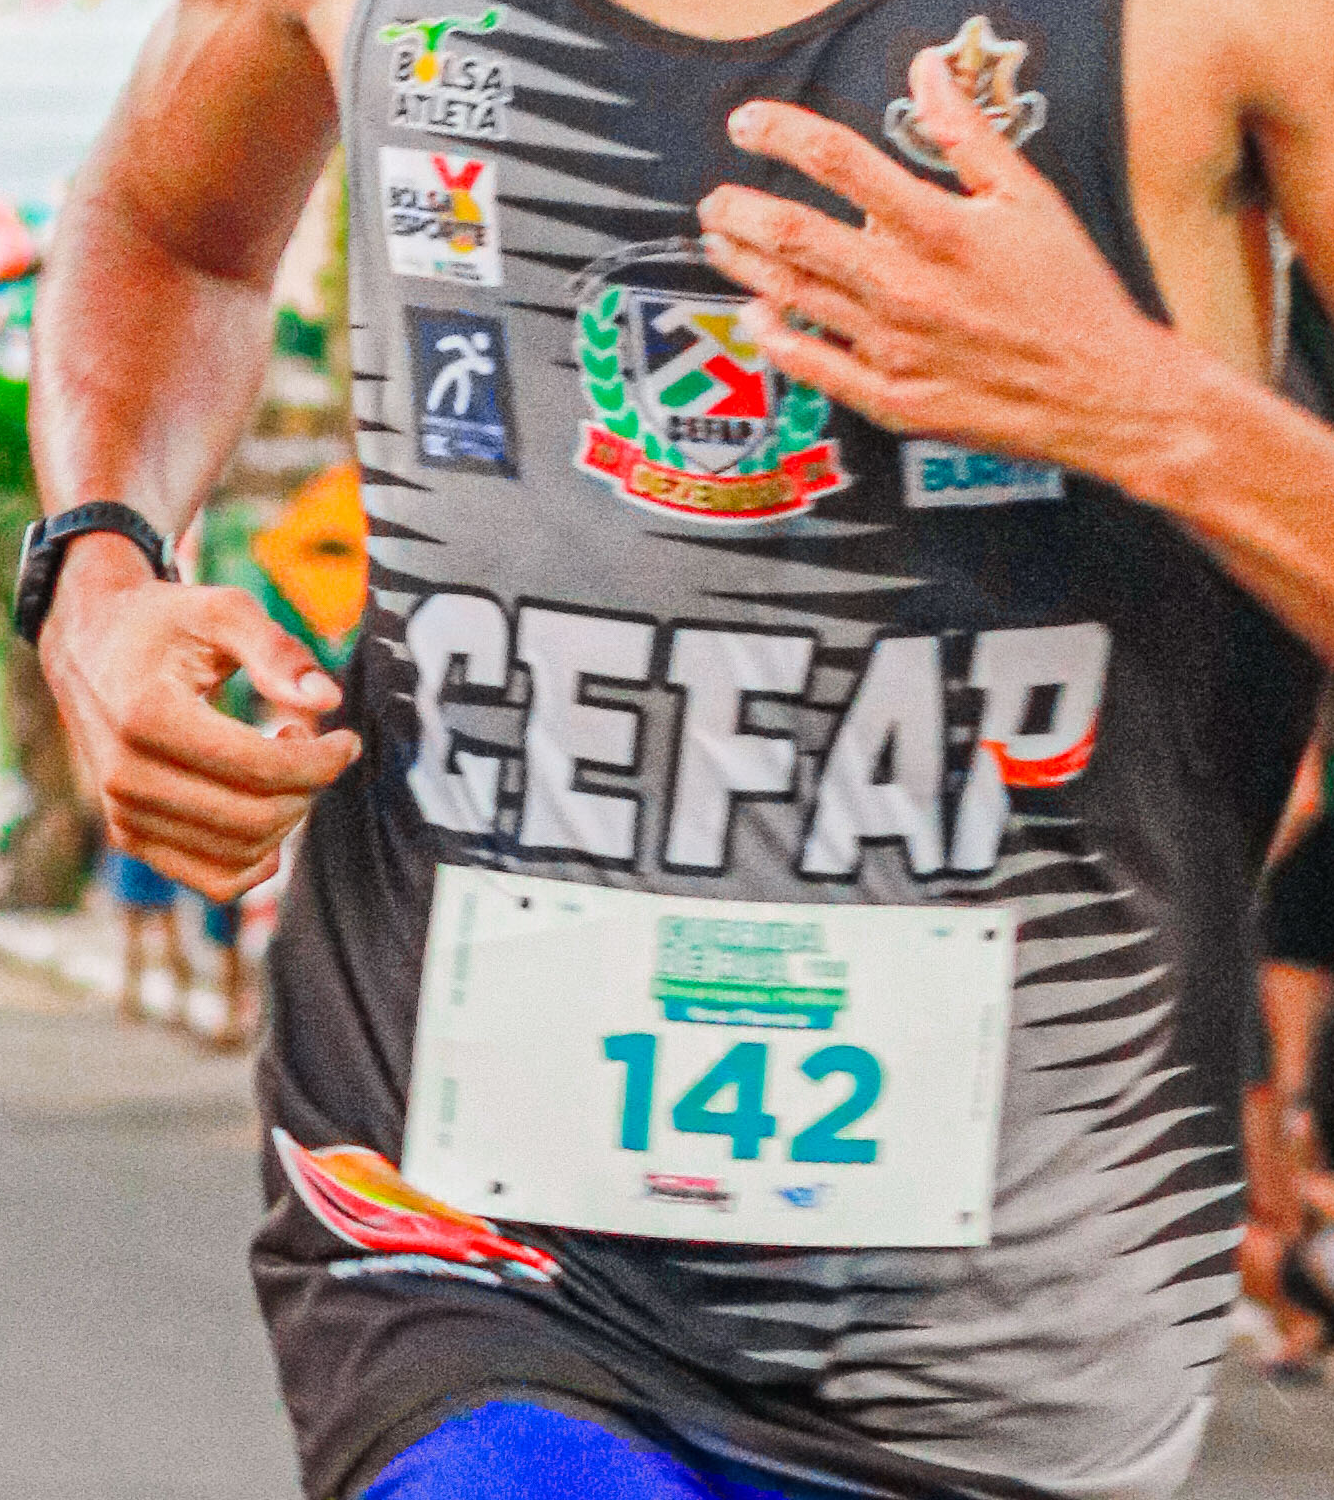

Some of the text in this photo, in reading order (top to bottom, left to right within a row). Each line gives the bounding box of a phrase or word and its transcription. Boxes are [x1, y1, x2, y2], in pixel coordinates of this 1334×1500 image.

[393, 92, 498, 130] ATLETA
[394, 50, 503, 91] BOLSA
[404, 590, 1113, 876] CEFAP
[603, 1032, 882, 1163] 142
